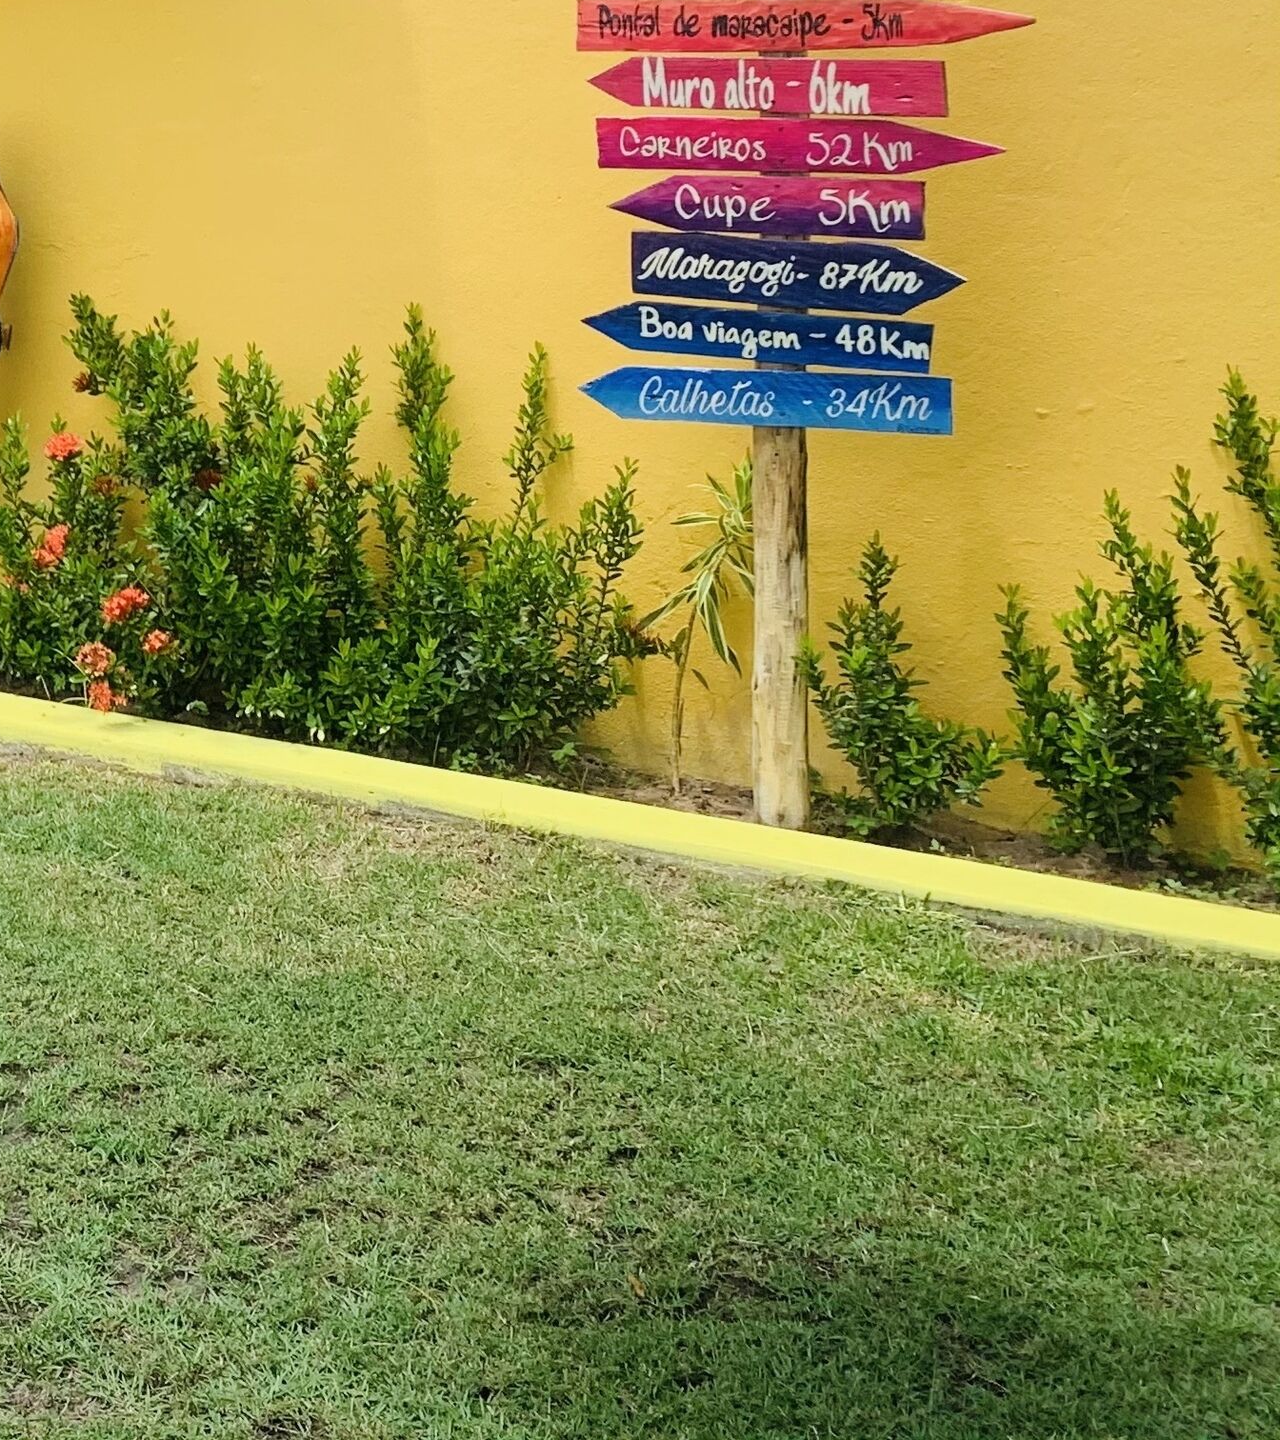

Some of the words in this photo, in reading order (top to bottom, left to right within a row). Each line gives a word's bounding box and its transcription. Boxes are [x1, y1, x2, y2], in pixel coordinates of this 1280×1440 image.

[597, 4, 661, 40] Pontal
[673, 5, 701, 38] de
[861, 3, 903, 41] 5km
[642, 56, 715, 108] Muro
[724, 58, 775, 110] alto
[809, 59, 872, 115] 6km
[620, 126, 767, 162] Carneiros
[674, 183, 777, 227] Cupe
[818, 188, 911, 233] 5Km
[819, 258, 923, 295] 87Km
[638, 305, 693, 341] Boa
[702, 322, 801, 359] viagem
[639, 375, 775, 418] Calhetas
[826, 382, 932, 420] 34Km
